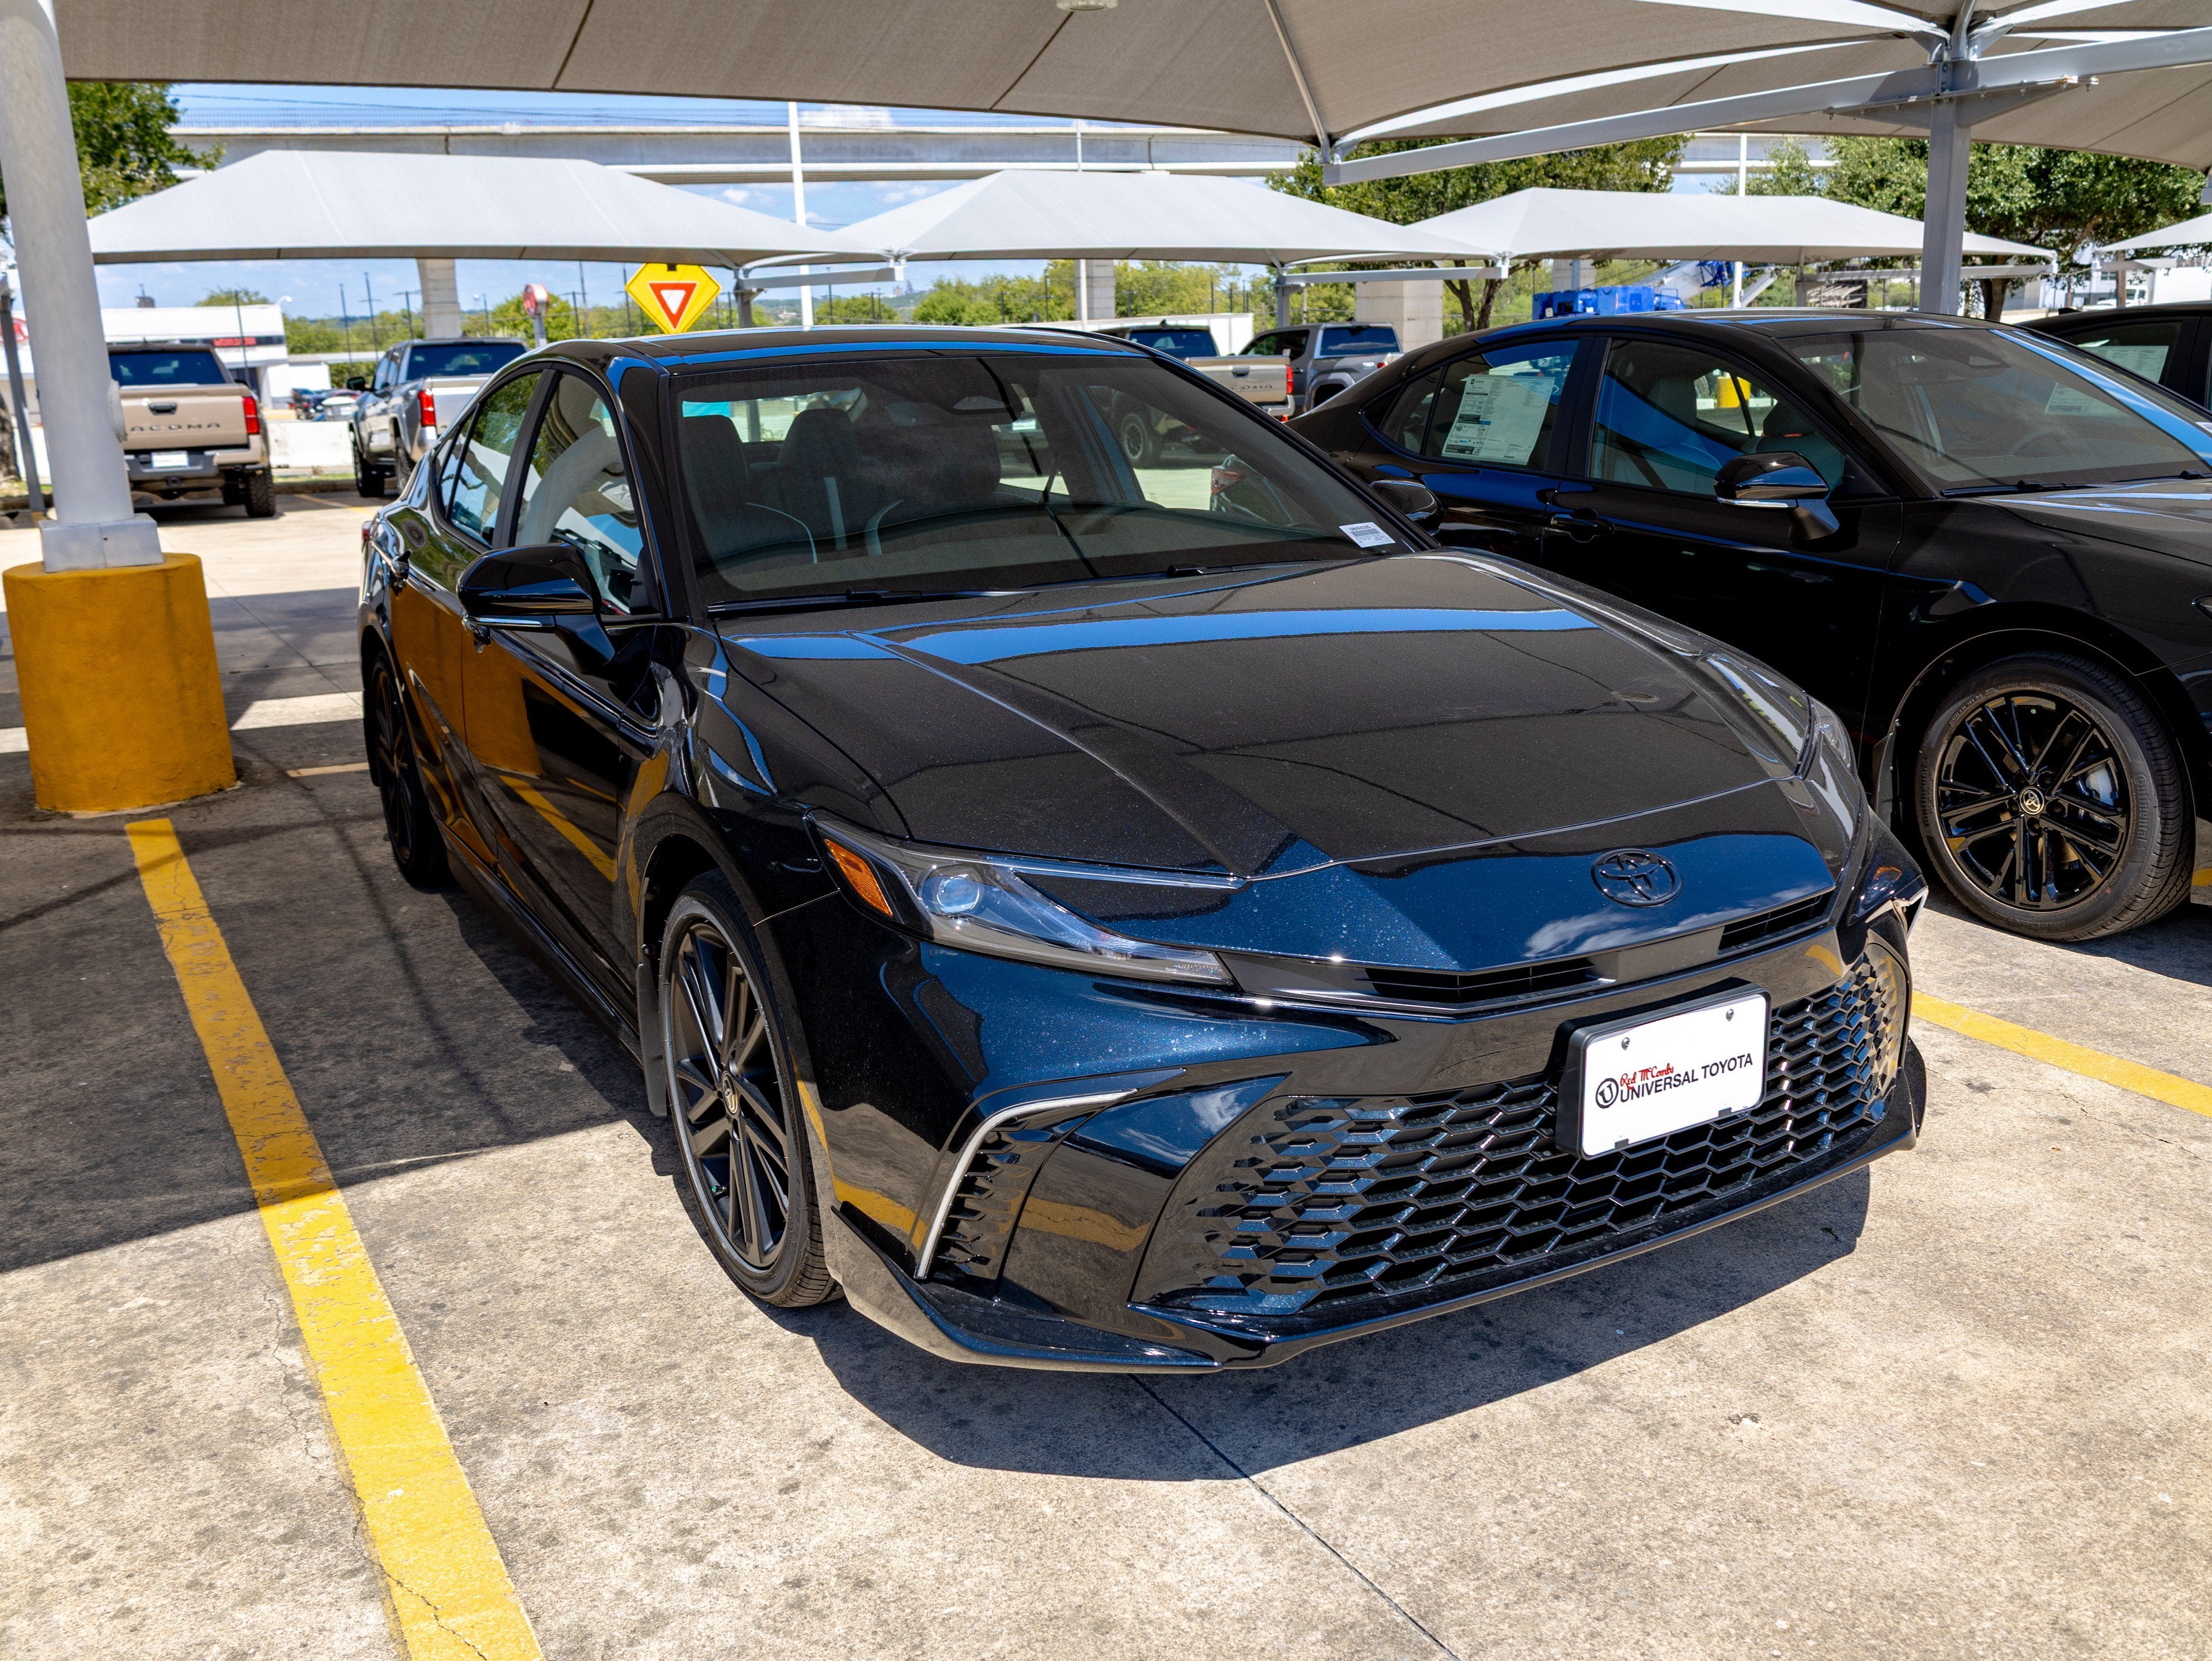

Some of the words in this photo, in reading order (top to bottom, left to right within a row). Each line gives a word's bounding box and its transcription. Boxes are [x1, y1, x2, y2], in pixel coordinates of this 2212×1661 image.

[131, 422, 221, 432] ACOMA
[1620, 1069, 1698, 1103] UNIVERSAL
[1701, 1053, 1753, 1079] TOYOTA
[1620, 1072, 1637, 1088] Red
